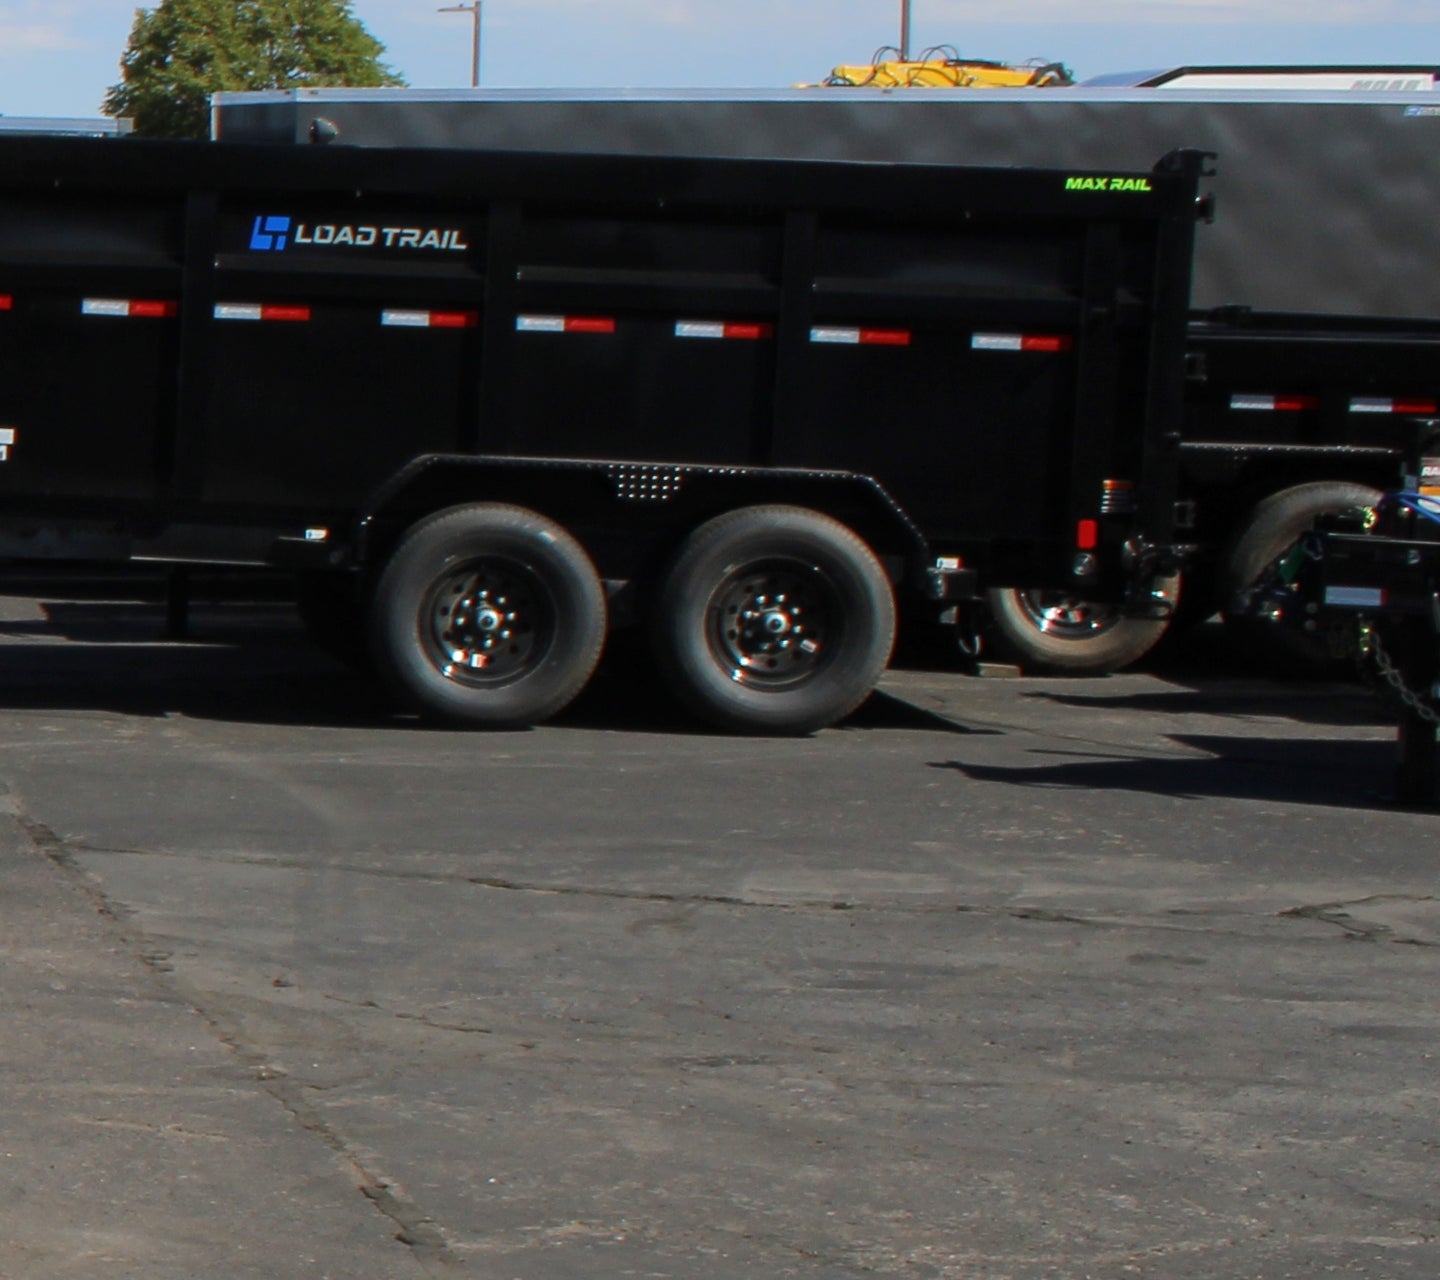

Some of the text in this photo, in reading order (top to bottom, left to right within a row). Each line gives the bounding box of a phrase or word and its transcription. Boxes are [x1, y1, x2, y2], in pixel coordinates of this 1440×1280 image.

[1065, 177, 1152, 191] MAX RAIL
[294, 224, 468, 250] LOAD TRAIL
